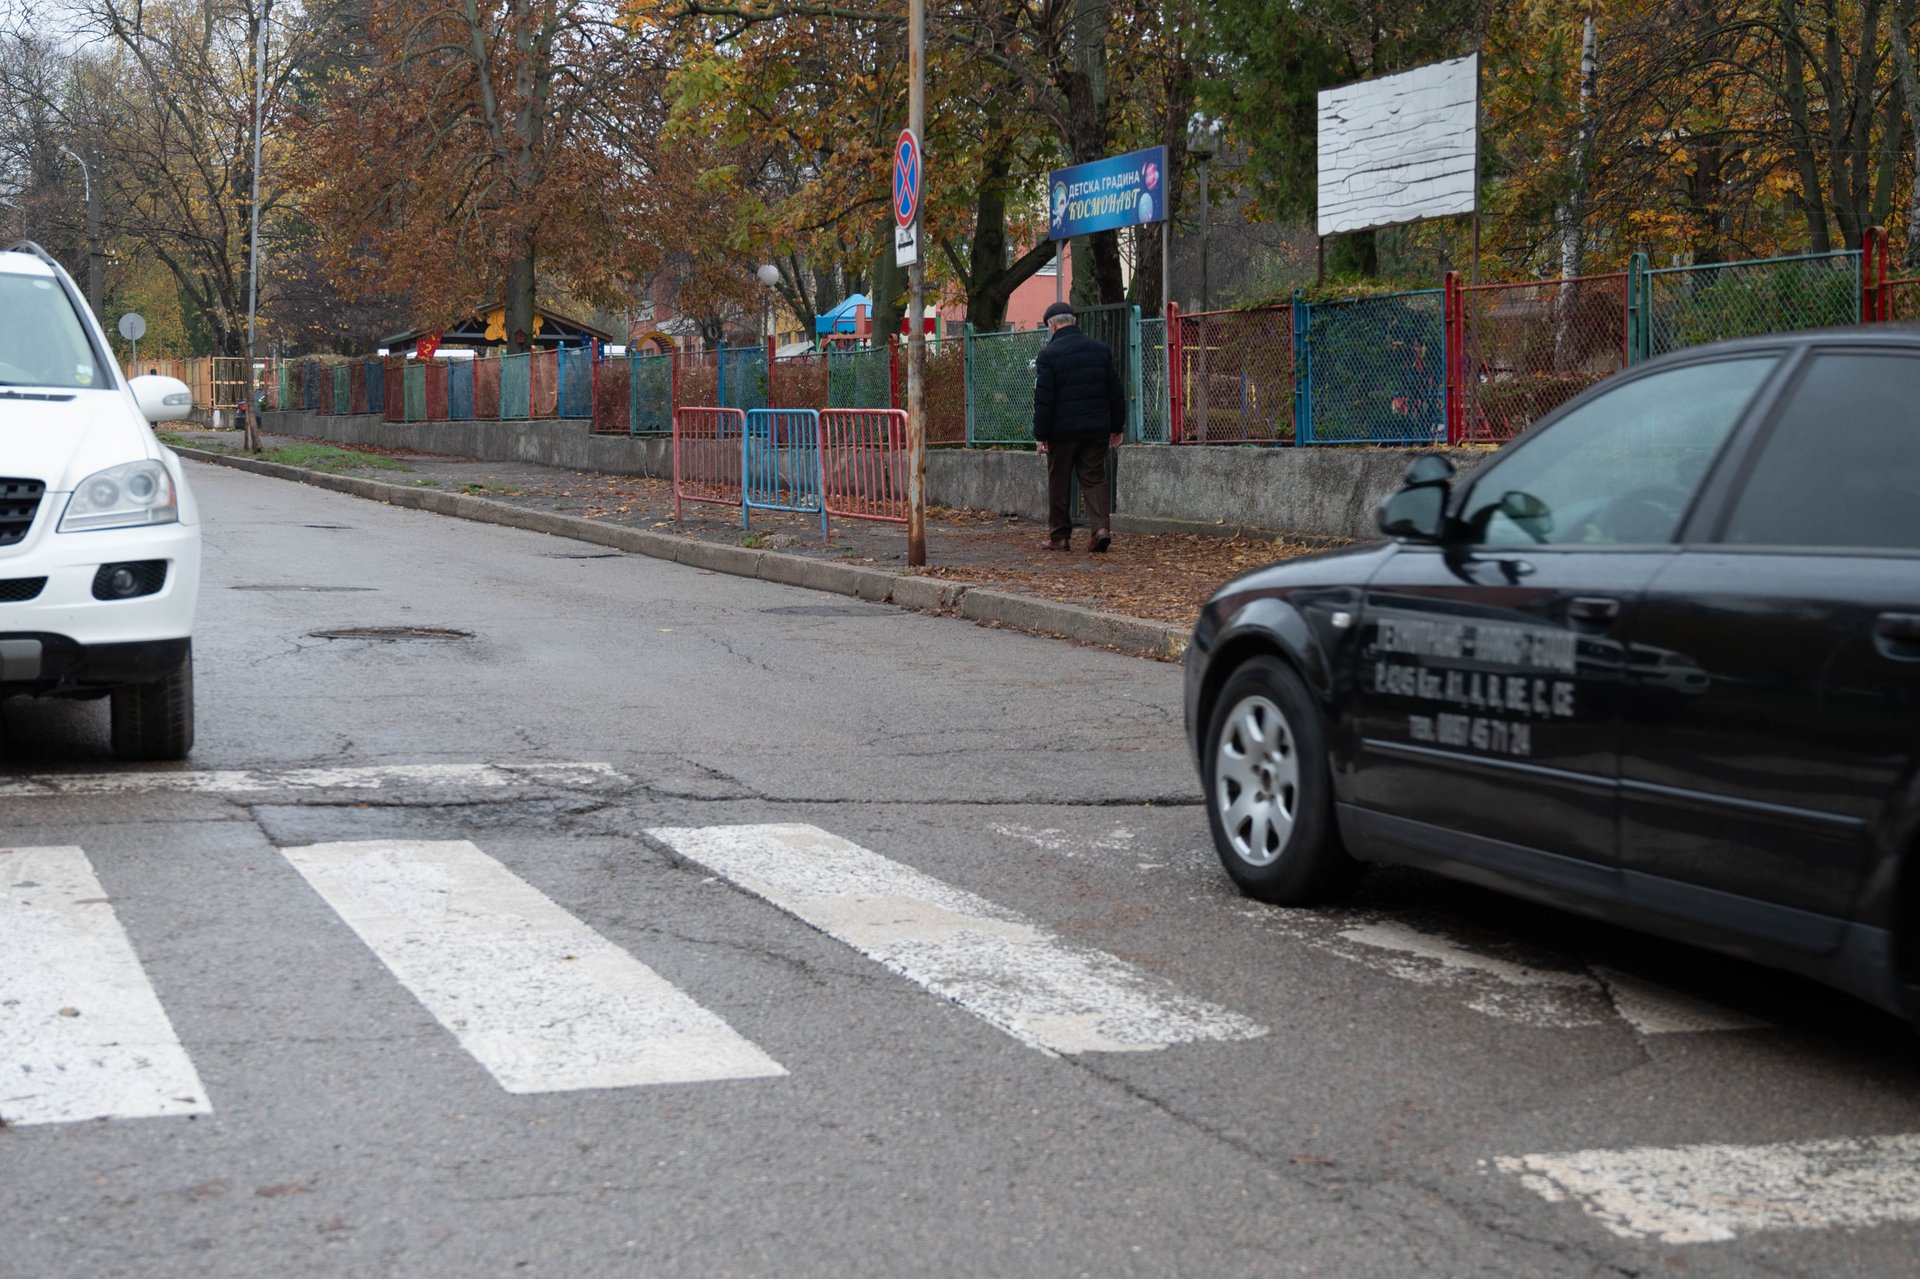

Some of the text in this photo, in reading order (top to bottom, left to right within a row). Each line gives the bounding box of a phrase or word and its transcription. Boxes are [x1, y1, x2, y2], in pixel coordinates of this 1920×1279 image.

[1069, 171, 1140, 198] ДЕТСКА ГРАДИНА
[1068, 189, 1141, 221] КОСМОНАВТ
